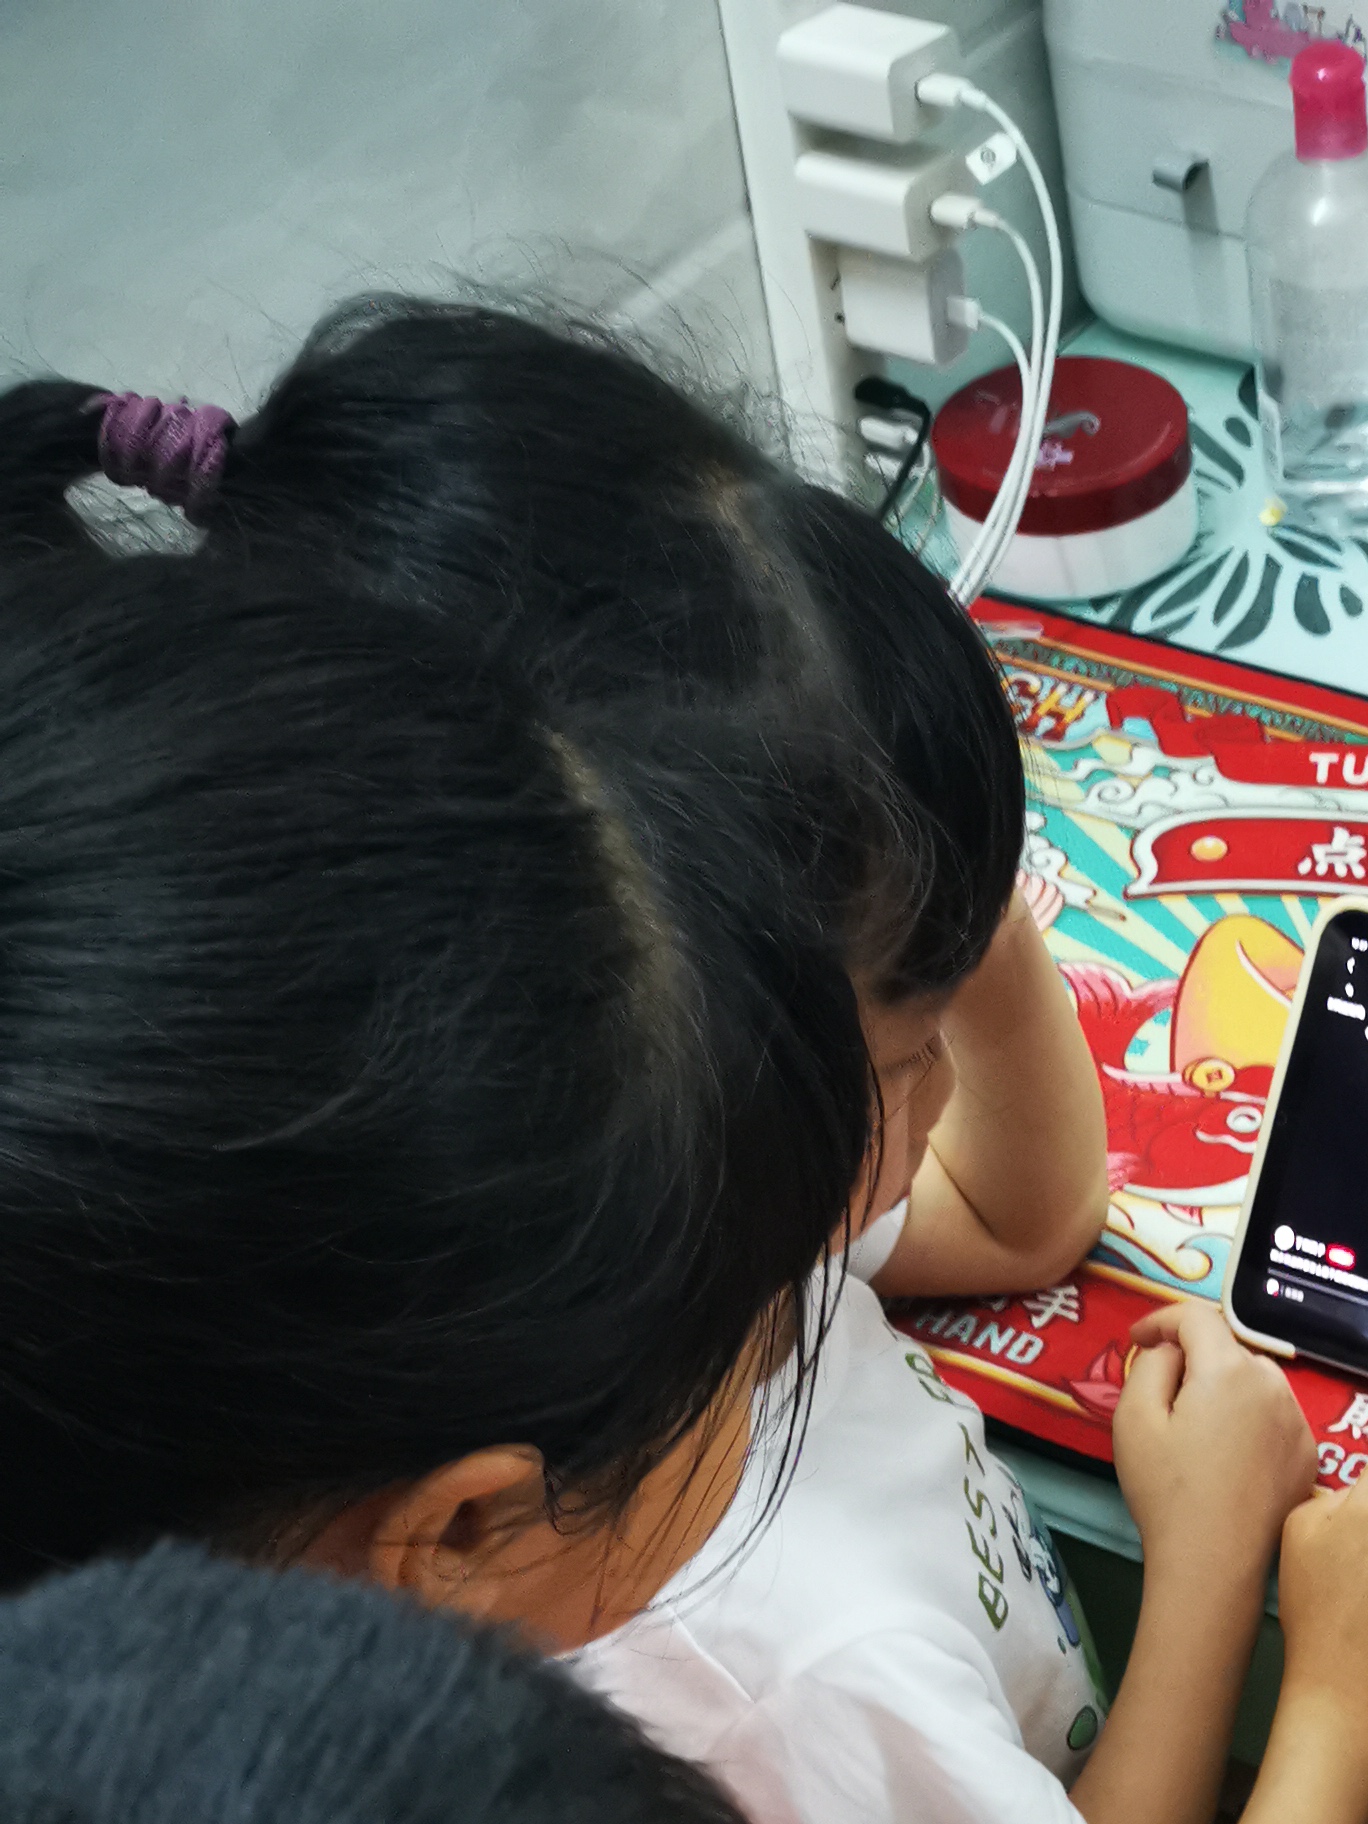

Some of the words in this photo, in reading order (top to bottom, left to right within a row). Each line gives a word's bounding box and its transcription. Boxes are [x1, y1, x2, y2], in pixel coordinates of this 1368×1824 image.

[1001, 671, 1096, 742] CH
[914, 1312, 1044, 1365] HAND
[964, 1420, 1009, 1632] BEST
